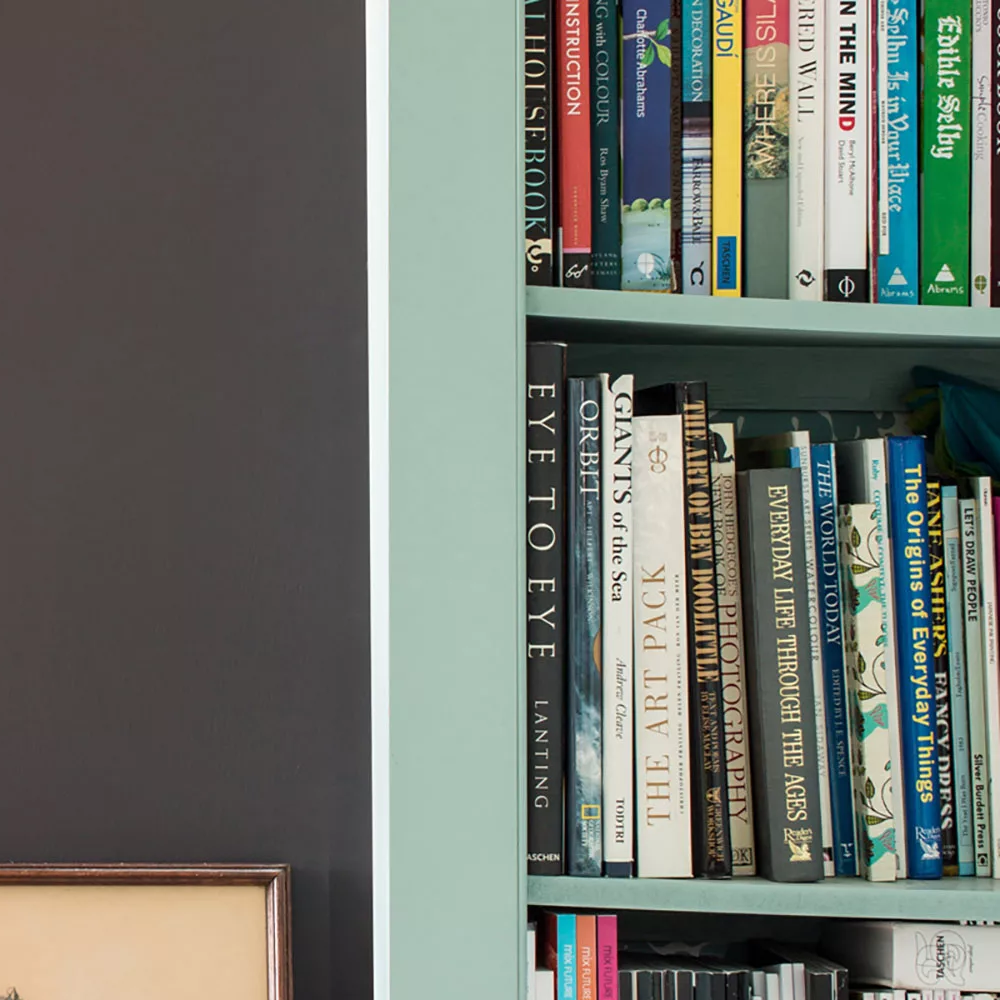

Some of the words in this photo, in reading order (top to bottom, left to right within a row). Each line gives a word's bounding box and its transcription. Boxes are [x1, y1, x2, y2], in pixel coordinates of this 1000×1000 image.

[595, 22, 606, 46] with
[716, 0, 738, 58] GAUDÍ
[839, 23, 856, 64] THE
[691, 10, 703, 102] DECORATION
[755, 47, 776, 68] IS
[596, 50, 610, 125] COLOUR
[636, 62, 647, 118] Abrahams
[798, 60, 816, 122] WALL
[838, 72, 856, 132] MIND
[755, 74, 776, 166] WHERE
[930, 94, 963, 160] Selby
[974, 112, 988, 160] Cooking
[600, 148, 608, 166] Ros
[838, 140, 846, 160] David
[847, 140, 856, 159] Beryl
[598, 170, 609, 195] Byam
[838, 162, 846, 184] Stuart
[600, 198, 610, 223] Shaw
[721, 241, 730, 284] TASCHEN
[927, 284, 964, 294] Abrams
[528, 384, 556, 463] EYE
[683, 401, 706, 442] THE
[579, 400, 599, 500] ORBIT
[612, 392, 632, 504] GIANTS
[684, 446, 708, 488] ART
[722, 476, 735, 512] JOHN
[816, 460, 832, 498] THE
[904, 464, 923, 504] The
[528, 487, 556, 552] TO
[612, 512, 628, 532] of
[687, 492, 710, 518] OF
[964, 507, 974, 538] LET'S
[612, 536, 628, 564] the
[688, 524, 712, 563] BEV
[768, 485, 794, 582] EVERYDAY
[819, 503, 836, 576] WORLD
[904, 510, 926, 591] Origins
[724, 515, 738, 596] HEDGECOE'S
[966, 541, 976, 574] DRAW
[611, 571, 628, 602] Sea
[928, 553, 947, 658] ASHER'S
[967, 579, 978, 622] PEOPLE
[528, 578, 556, 658] EYE
[641, 564, 668, 652] PACK
[691, 568, 720, 684] DOOLITTLE
[774, 588, 796, 628] LIFE
[824, 579, 840, 645] TODAY
[911, 598, 928, 618] of
[615, 658, 627, 700] Andrew
[776, 634, 802, 724] THROUGH
[831, 668, 842, 706] EDITED
[910, 627, 932, 726] Everyday
[615, 704, 627, 740] Cleave
[644, 669, 669, 738] ART
[718, 602, 748, 824] PHOTOGRAPHY
[834, 708, 842, 720] BY
[934, 672, 949, 754] FANCY
[534, 700, 549, 808] LANTING
[782, 728, 804, 768] THE
[836, 741, 848, 778] SPENCE
[916, 732, 934, 803] Things
[974, 754, 984, 780] Silver
[646, 754, 670, 827] THE
[784, 772, 807, 822] AGES
[975, 784, 985, 820] Burdett
[615, 798, 625, 844] TODTRI
[706, 806, 716, 858] WORKSHOP
[713, 803, 724, 862] GREENWICH
[977, 824, 986, 848] Press
[563, 944, 574, 964] mix
[581, 946, 593, 966] mix
[602, 946, 613, 966] mix
[936, 936, 944, 978] TASCHEN
[563, 966, 573, 998] FUTURE
[581, 968, 592, 1000] FUTURE
[603, 967, 612, 998] FUTURE
